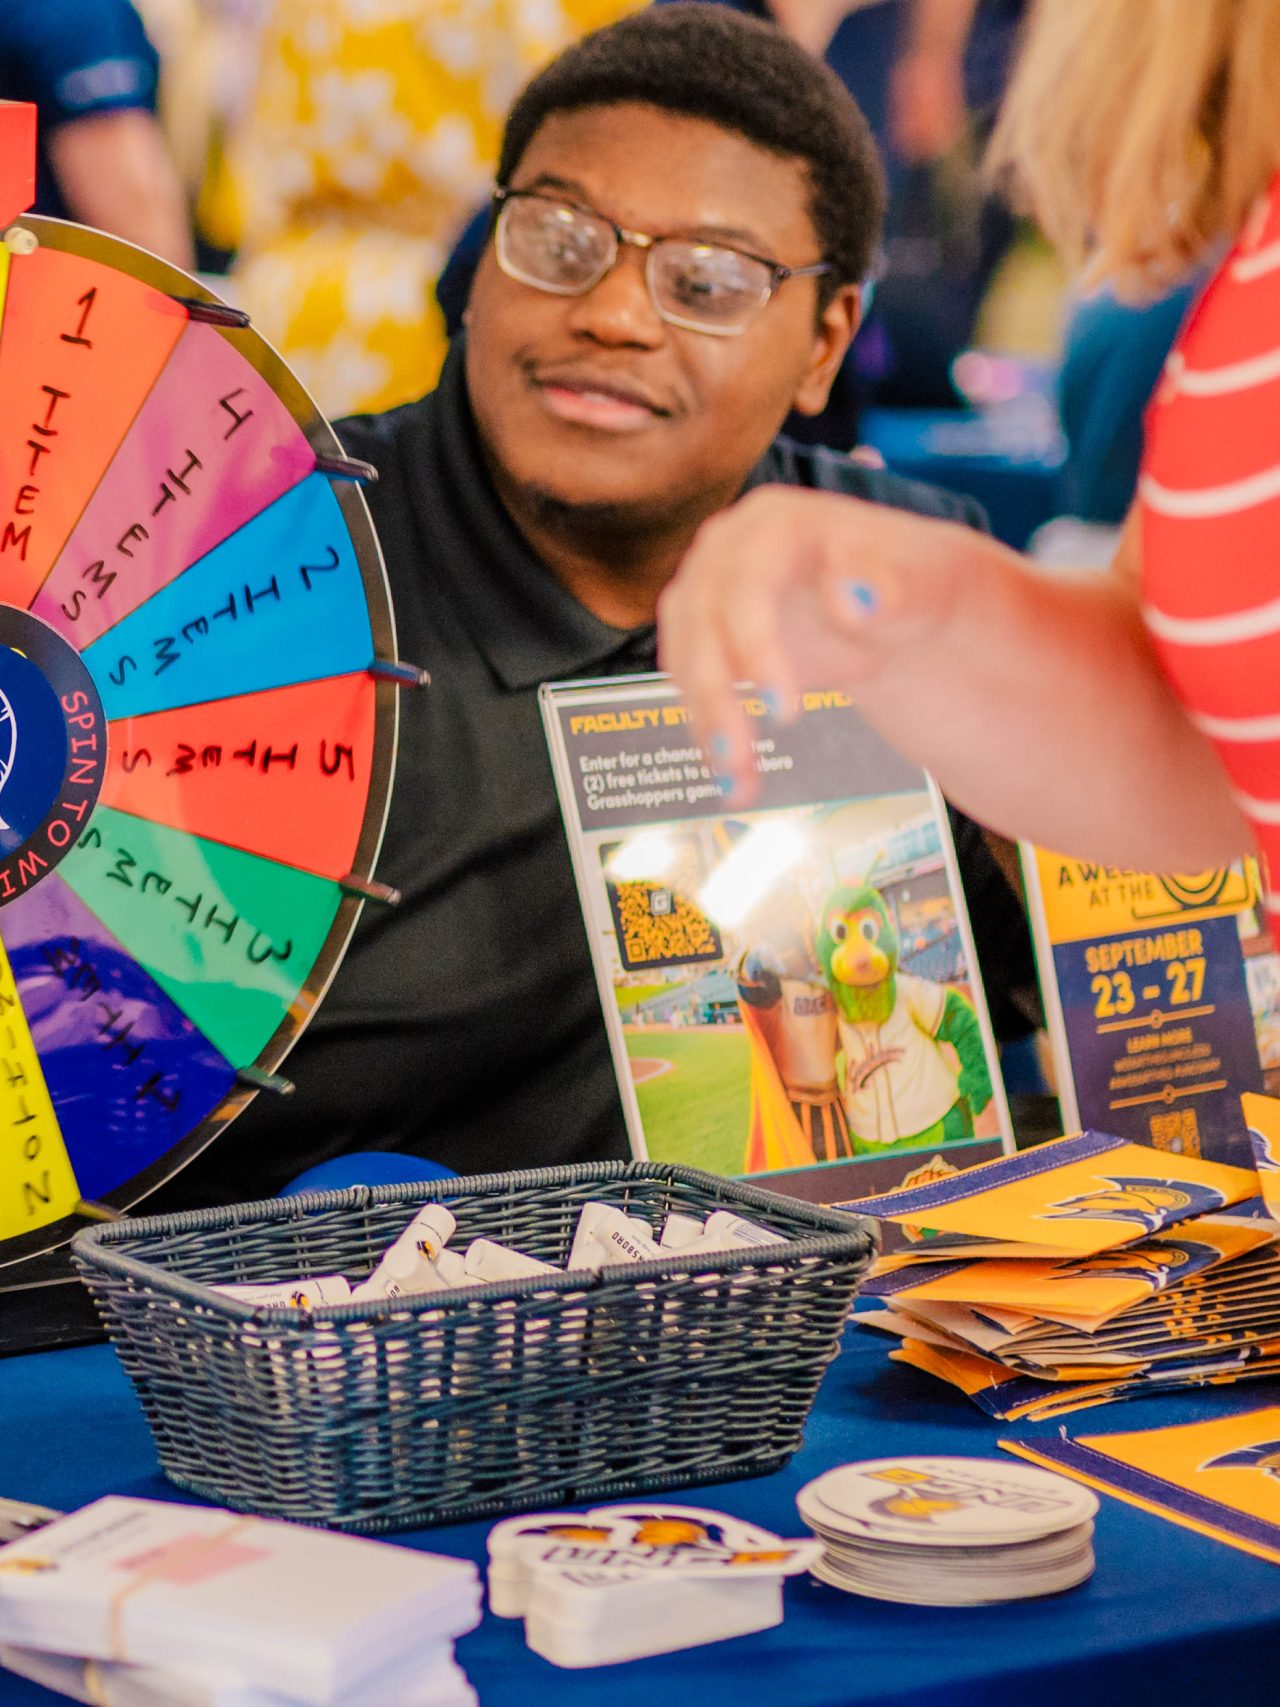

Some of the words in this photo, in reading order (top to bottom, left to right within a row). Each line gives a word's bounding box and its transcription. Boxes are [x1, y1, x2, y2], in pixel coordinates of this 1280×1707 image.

[60, 286, 97, 350] 1
[218, 387, 253, 441] 4
[0, 384, 71, 562] ITEM
[61, 448, 204, 622] ITEMS
[299, 545, 340, 591] 2
[108, 574, 281, 686] ITEMS
[61, 690, 98, 785] SPIN
[570, 709, 661, 735] FACULTY
[121, 738, 299, 777] ITEMS
[319, 738, 355, 782] 5
[579, 753, 619, 773] Enter
[620, 751, 641, 769] for
[642, 752, 653, 765] a
[583, 775, 605, 794] (2)
[606, 771, 636, 788] free
[637, 765, 683, 784] tickets
[684, 765, 699, 780] to
[587, 787, 684, 811] Grasshoppers
[47, 798, 89, 848] TO
[77, 826, 241, 945] ITEMS
[1090, 886, 1110, 909] AT
[1119, 880, 1155, 905] THE
[246, 929, 293, 965] 3
[1085, 928, 1204, 973] SEPTEMBER
[1091, 971, 1135, 1018] 23
[1166, 957, 1206, 1005] 27
[611, 1231, 646, 1263] NSBORO
